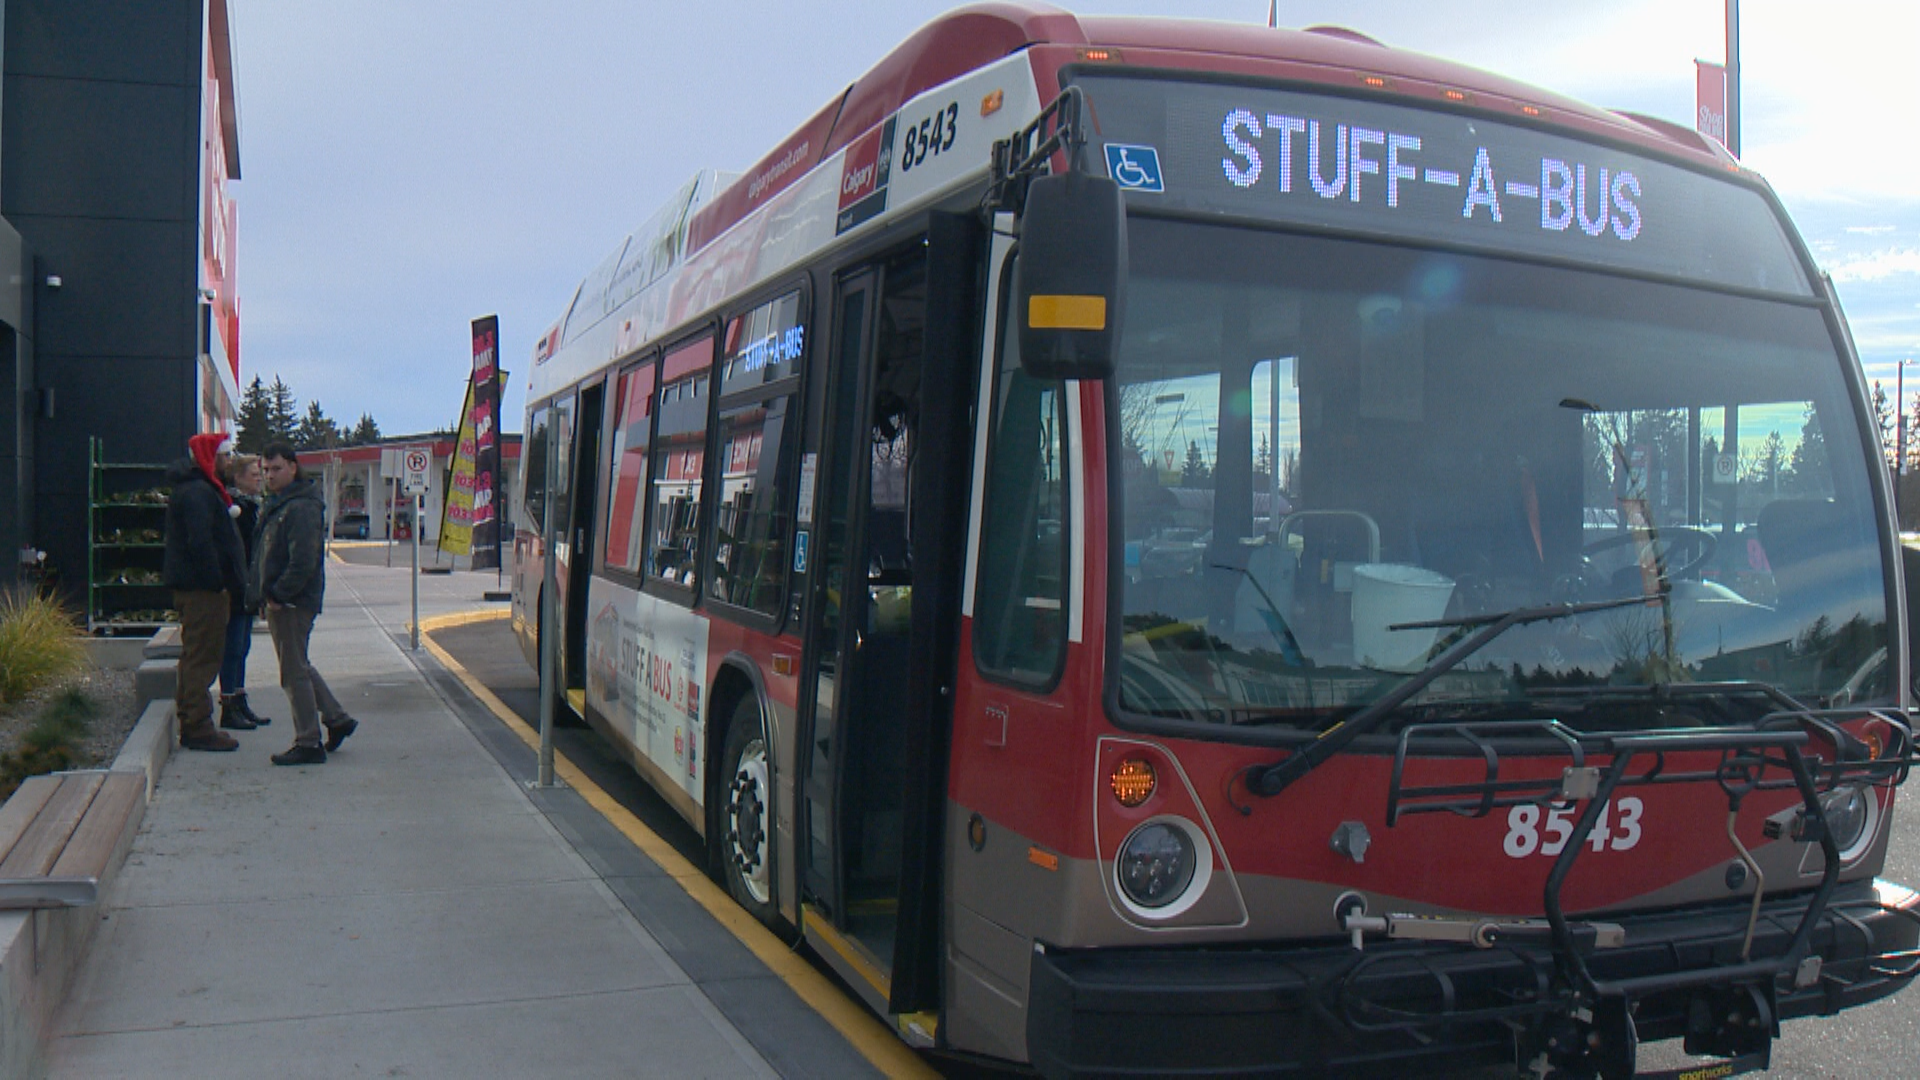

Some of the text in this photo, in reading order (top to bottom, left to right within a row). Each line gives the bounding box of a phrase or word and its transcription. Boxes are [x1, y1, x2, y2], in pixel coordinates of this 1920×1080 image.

[902, 101, 958, 172] 8543
[843, 163, 874, 195] Calgary
[1222, 107, 1642, 241] STUFF-A-BUS
[621, 638, 645, 682] STUFF
[645, 652, 652, 689] A
[653, 654, 673, 703] BUS
[1503, 797, 1644, 858] 8543
